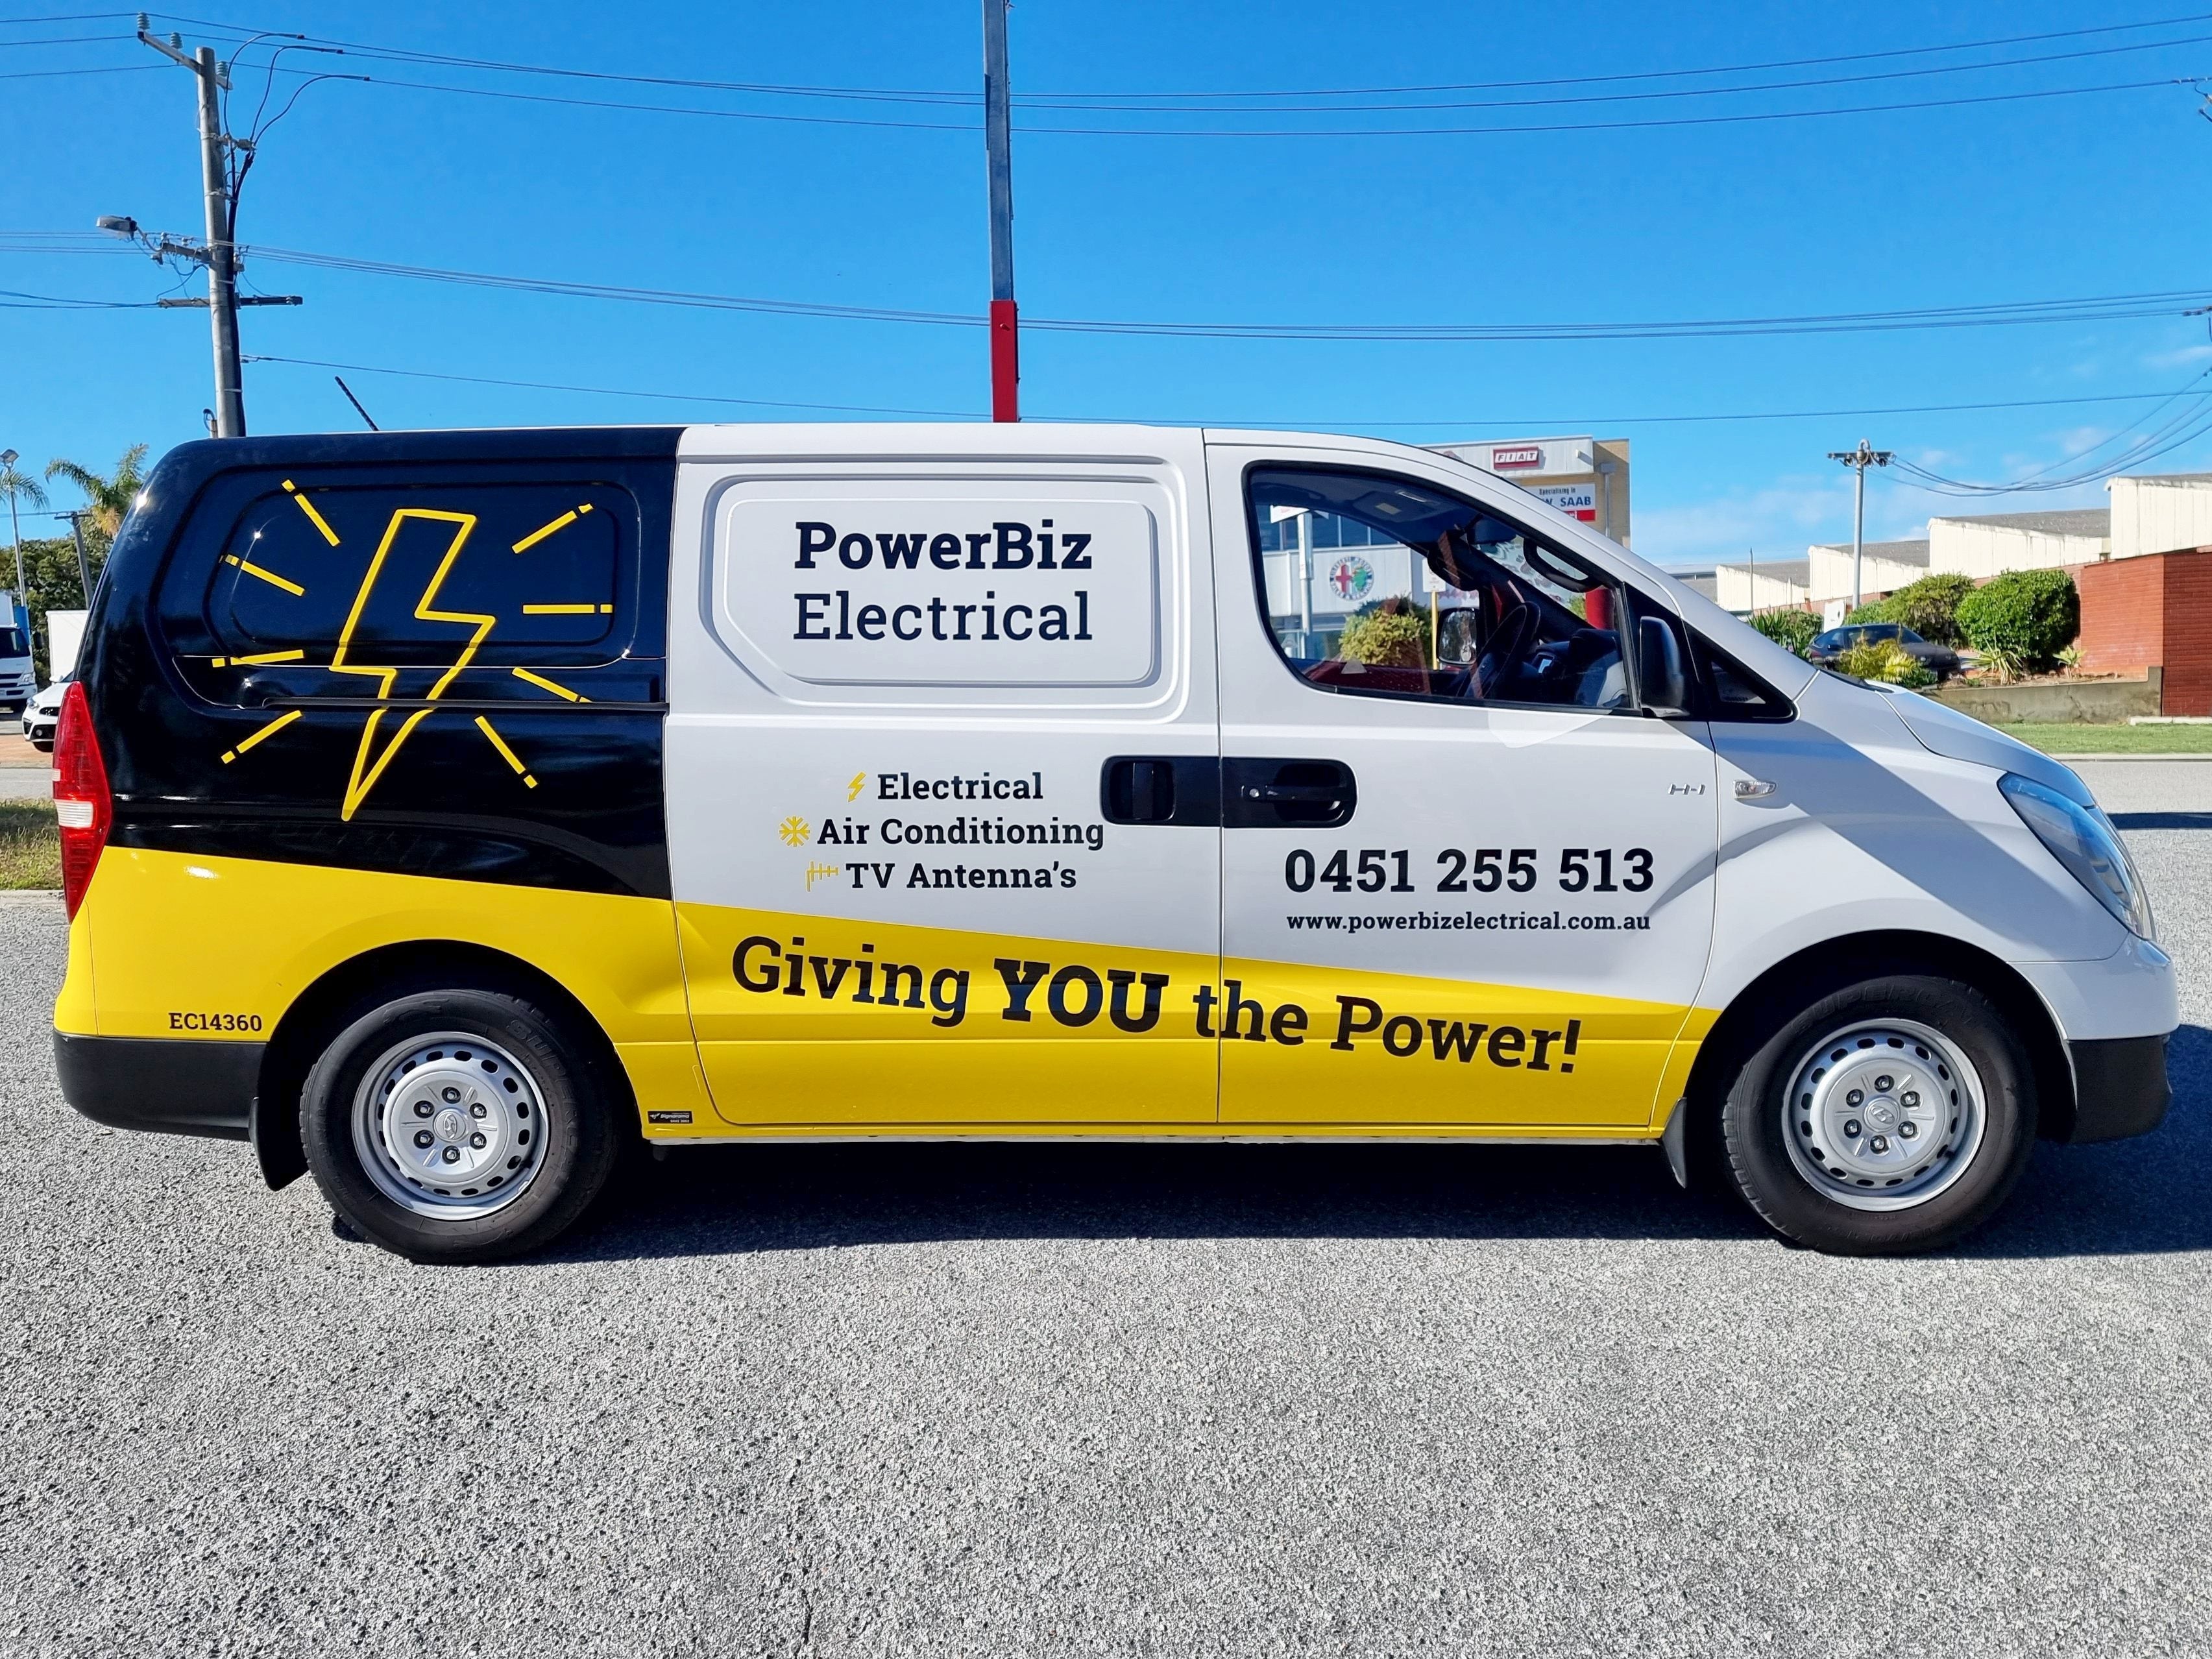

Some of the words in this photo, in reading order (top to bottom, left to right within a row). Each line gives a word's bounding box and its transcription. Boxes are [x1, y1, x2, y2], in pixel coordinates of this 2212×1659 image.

[1498, 452, 1536, 462] FIAT
[1560, 496, 1591, 507] SAAB
[794, 518, 1093, 570] PowerBiz
[793, 590, 1093, 641] Electrical
[877, 772, 1043, 800] Electrical
[817, 817, 870, 845] Air
[881, 816, 1104, 851] Conditioning
[845, 863, 895, 889] TV
[1285, 849, 1415, 893] 0451
[1437, 849, 1537, 893] 255
[1559, 848, 1654, 893] 513
[1286, 911, 1651, 934] www.powerbizelectrical.com.au
[732, 936, 970, 1028] Giving
[993, 958, 1170, 1033] YOU
[1193, 980, 1308, 1046] the
[1330, 995, 1581, 1073] Power!
[168, 1012, 262, 1032] EC14360
